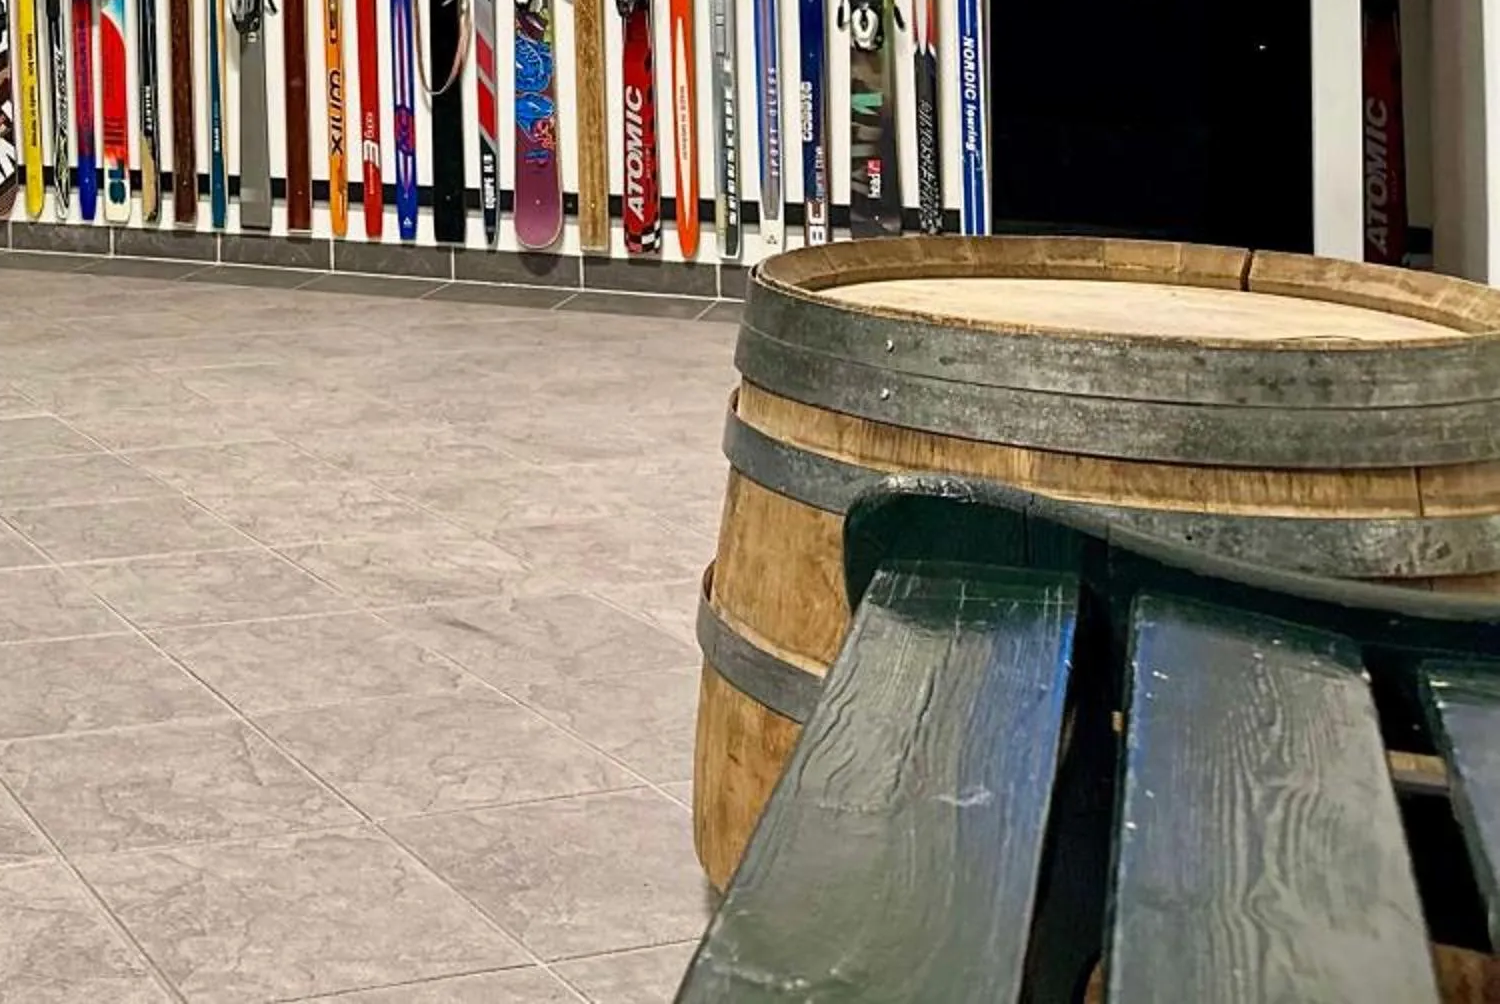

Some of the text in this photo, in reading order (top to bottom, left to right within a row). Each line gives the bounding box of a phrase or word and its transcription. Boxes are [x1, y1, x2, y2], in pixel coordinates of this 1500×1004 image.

[625, 86, 644, 222] ATOMIC
[963, 35, 978, 152] NORDIC touring
[868, 173, 880, 199] head
[1366, 97, 1388, 255] ATOMIC
